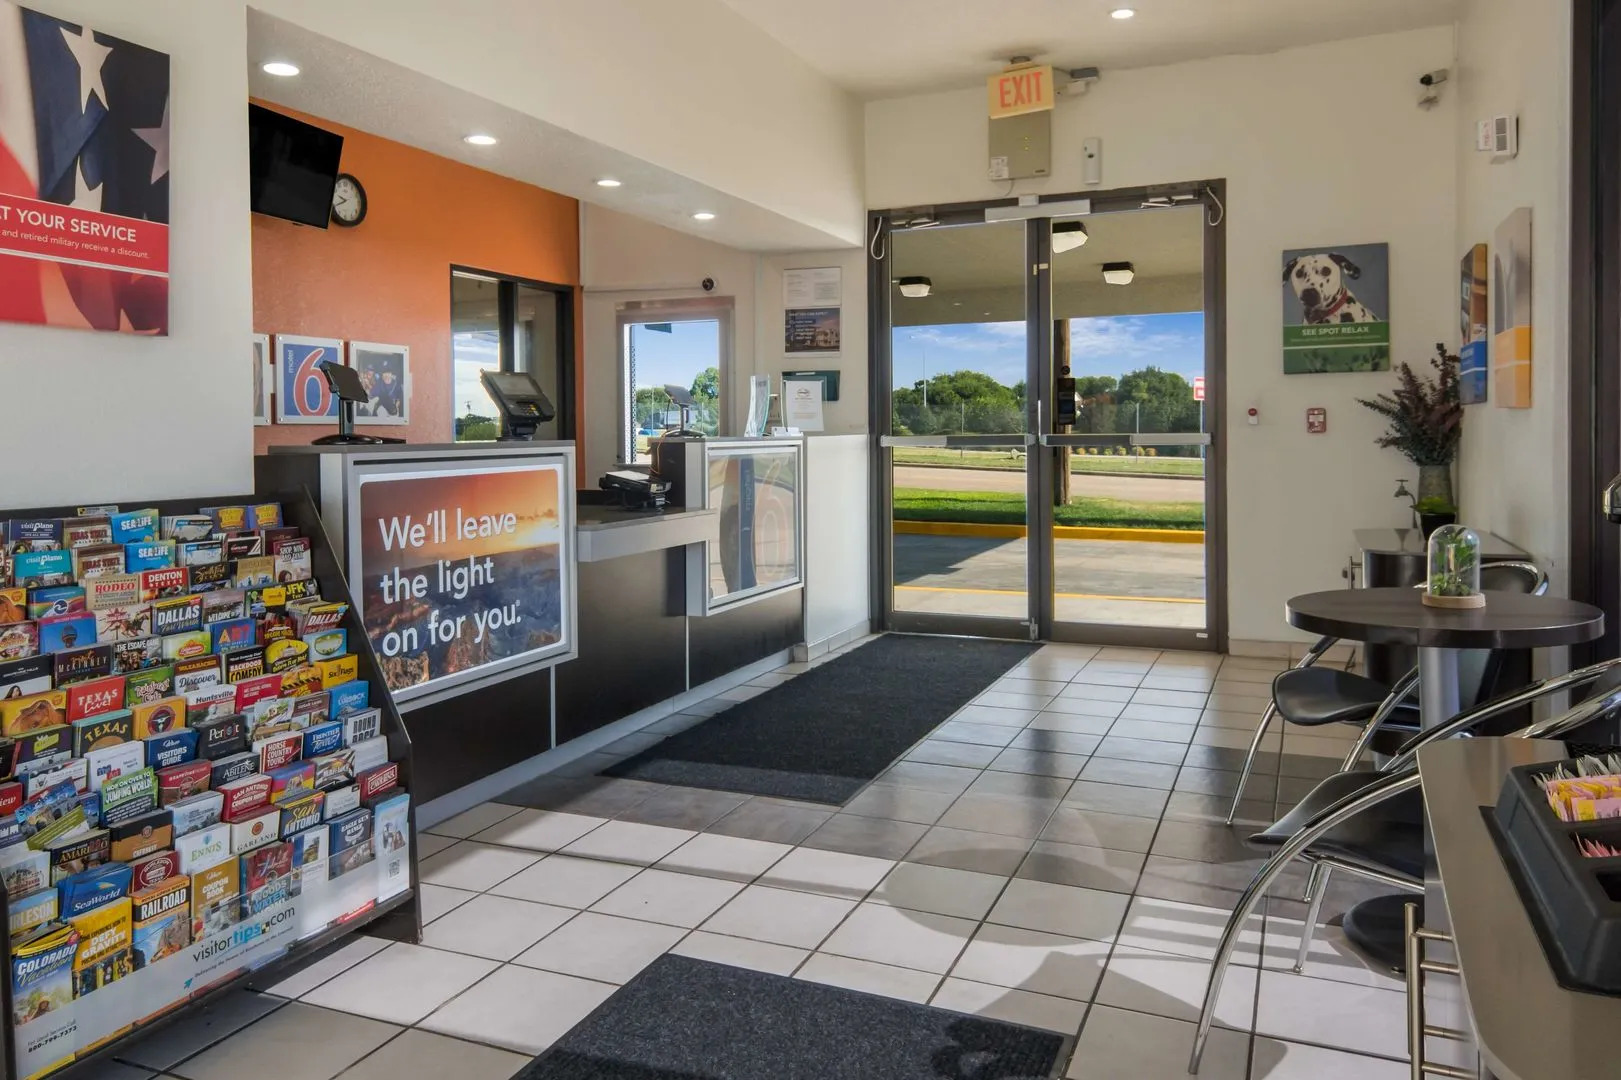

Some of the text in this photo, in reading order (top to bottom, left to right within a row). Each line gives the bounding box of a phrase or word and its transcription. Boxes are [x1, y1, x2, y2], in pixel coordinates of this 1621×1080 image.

[1000, 72, 1042, 108] EXIT
[16, 208, 65, 230] YOUR
[70, 218, 136, 242] SERVICE
[2, 229, 18, 239] and
[20, 232, 48, 242] retired
[50, 237, 79, 249] military
[82, 242, 108, 253] receive
[1302, 328, 1316, 336] SEE
[1318, 327, 1340, 335] SPOT
[293, 348, 332, 416] 6
[121, 516, 152, 531] SEA LIFE
[378, 508, 517, 550] We'll leave
[138, 545, 168, 558] SEA LIFE
[148, 571, 183, 582] DENTON
[380, 554, 494, 604] the light
[96, 582, 135, 594] RODEO
[286, 582, 306, 595] JFK
[158, 605, 200, 626] DALLAS
[309, 612, 344, 626] DALLAS
[382, 626, 418, 656] on
[428, 609, 466, 645] for
[117, 643, 127, 651] THE
[128, 641, 146, 650] ESCAPE
[230, 659, 262, 672] BACKDOOR
[230, 666, 263, 682] COMEDY
[340, 666, 354, 674] Flags
[180, 672, 216, 687] Discover
[78, 689, 118, 706] TEXAS
[84, 695, 111, 714] Live!
[196, 690, 234, 704] Huntsville
[84, 722, 128, 742] TEXAS
[312, 726, 340, 740] FRONTIER
[353, 715, 377, 734] ROUND
[157, 746, 187, 760] VISITORS
[267, 740, 286, 751] HORSE
[268, 746, 292, 758] COUNTRY
[162, 755, 181, 766] GUIDE
[267, 757, 285, 767] TOURS
[223, 762, 254, 779] ABILENE
[106, 784, 118, 792] HOP
[118, 780, 127, 788] ON
[128, 775, 142, 784] OVER
[106, 787, 132, 804] JUMPING
[233, 788, 244, 800] SAN
[294, 803, 316, 821] San
[284, 813, 320, 835] ANTONIO
[61, 838, 108, 861] AMARILLO
[237, 832, 276, 851] GARLAND
[192, 841, 221, 861] ENNIS
[202, 877, 228, 894] COUPON
[206, 886, 224, 900] BOOK
[74, 888, 121, 912] SeaWorld
[142, 888, 186, 920] RAILROAD
[82, 931, 125, 958] GRAVITY
[91, 927, 117, 946] DEFY
[17, 944, 77, 975] COLORADO
[17, 956, 72, 986] Vacation
